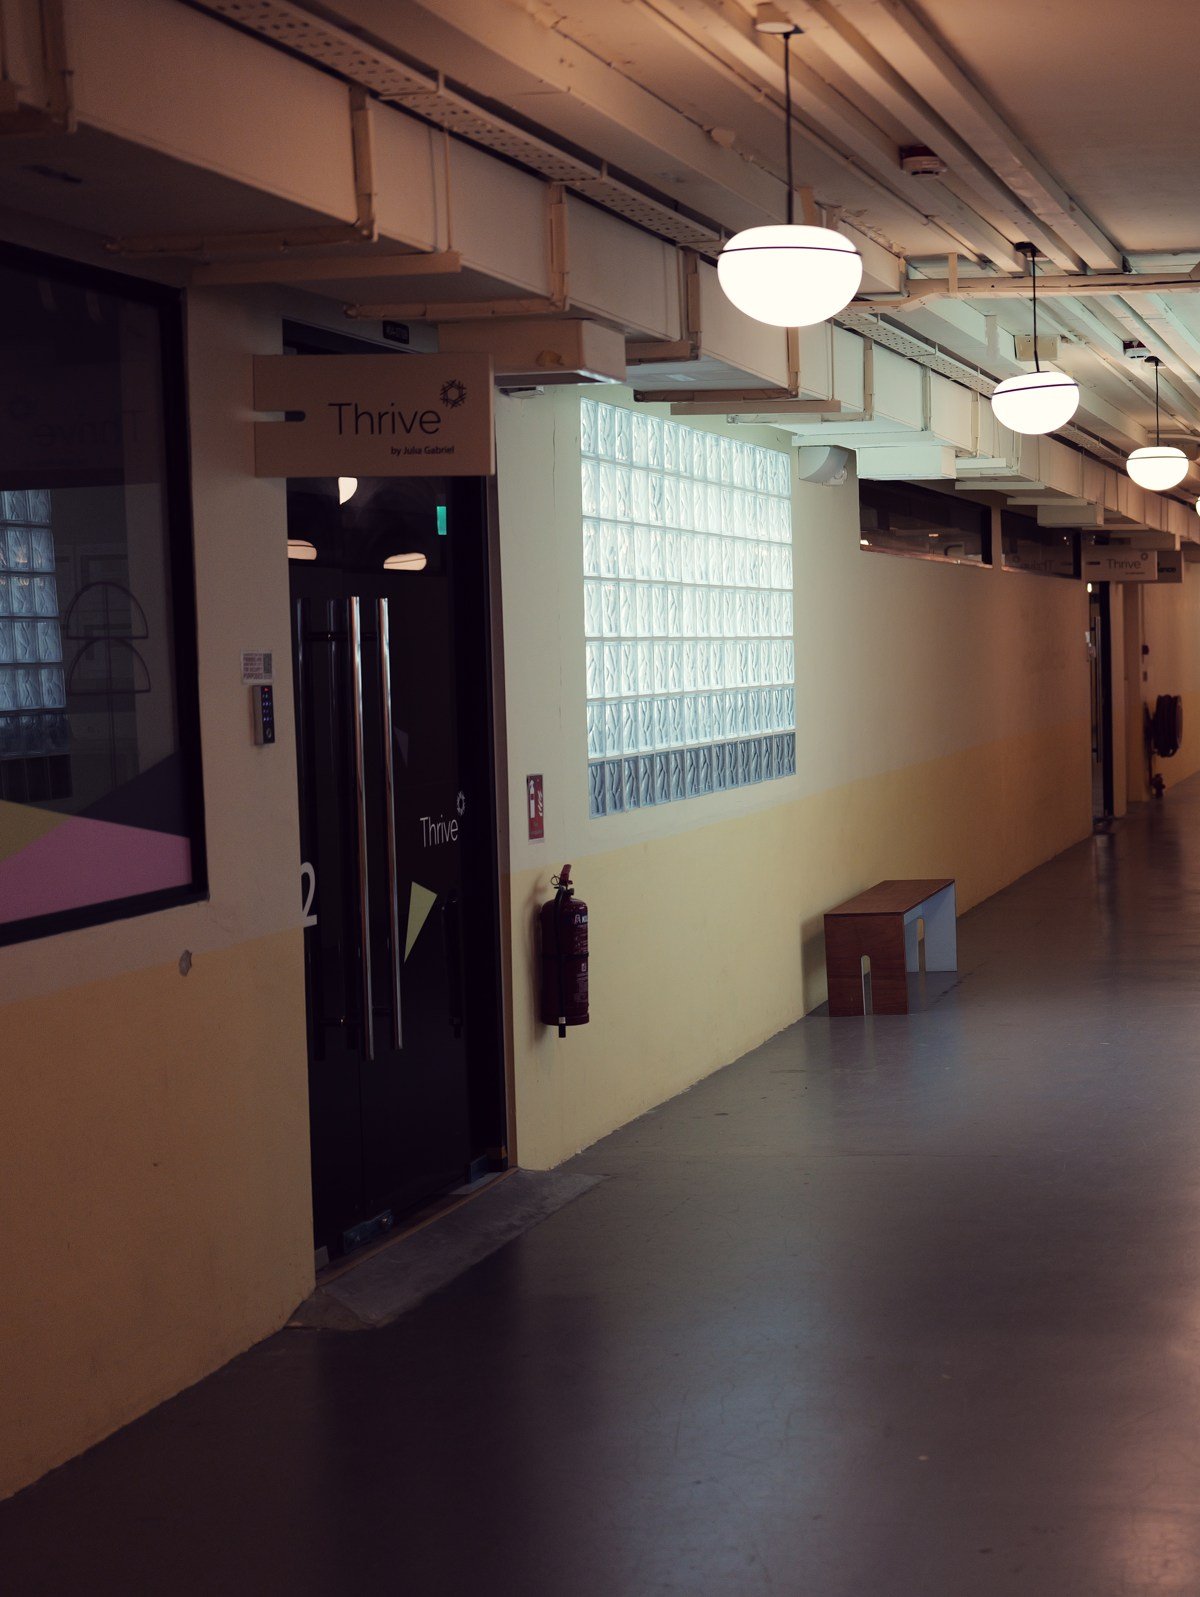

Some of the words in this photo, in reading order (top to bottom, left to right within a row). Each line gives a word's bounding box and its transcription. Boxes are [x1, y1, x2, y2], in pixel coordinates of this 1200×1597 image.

[328, 402, 442, 435] Thrive
[390, 446, 401, 456] by
[403, 446, 422, 455] Julia
[424, 446, 455, 455] Gabriel
[1107, 558, 1142, 569] Thrive
[420, 814, 459, 848] Thrive
